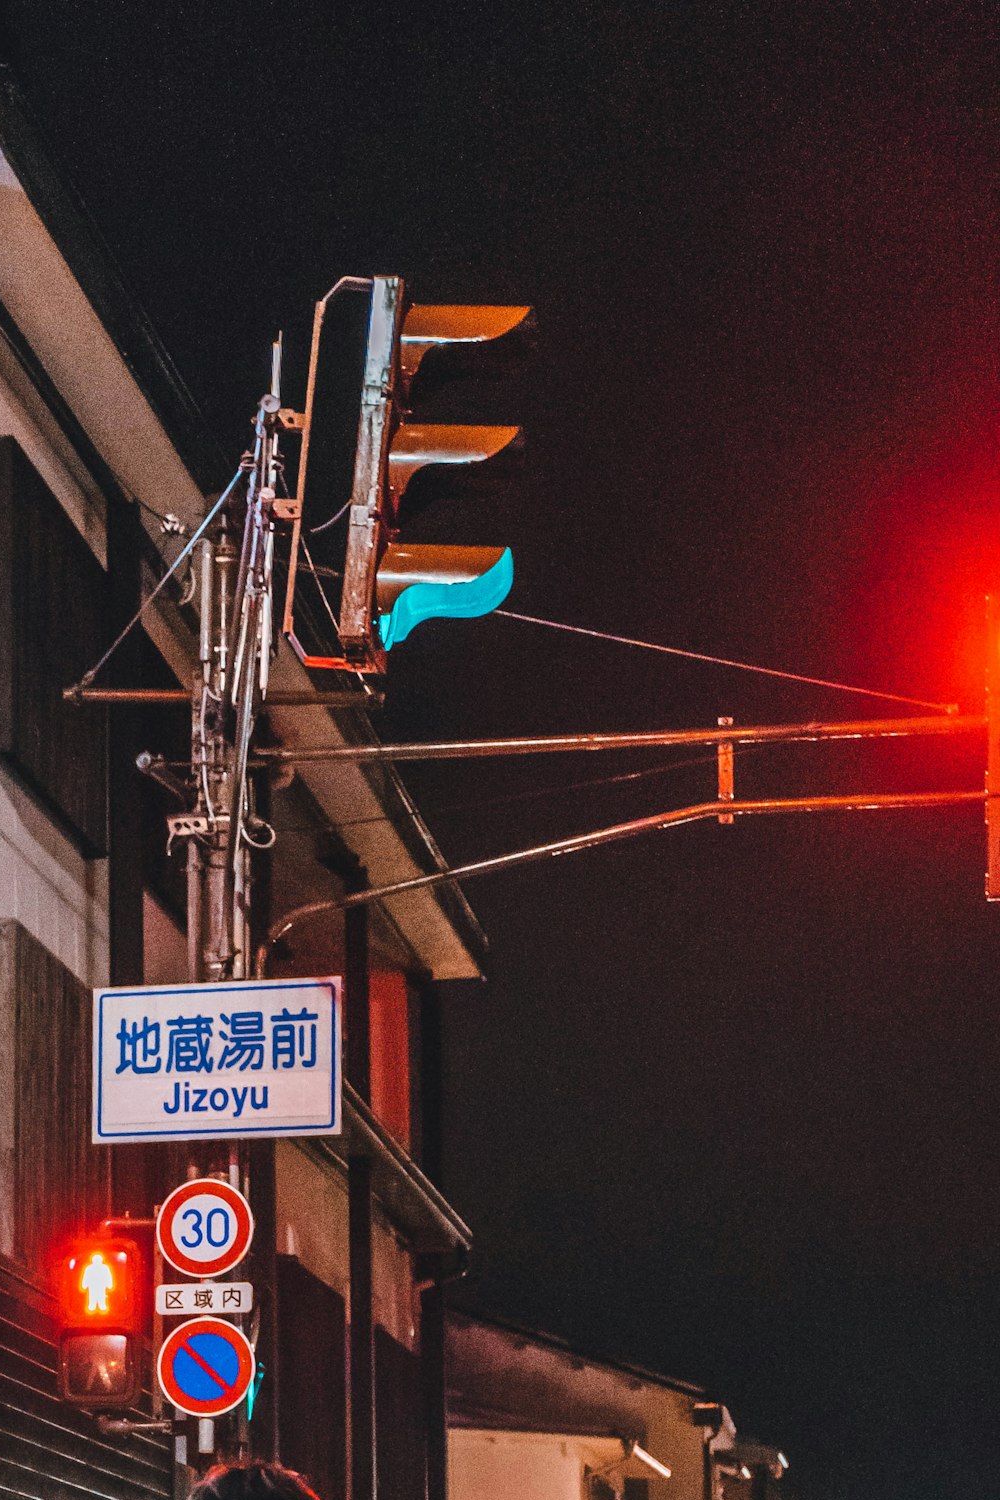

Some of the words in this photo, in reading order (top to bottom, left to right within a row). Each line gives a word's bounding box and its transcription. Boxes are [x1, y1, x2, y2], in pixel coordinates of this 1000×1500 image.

[115, 1007, 319, 1075] 地蔵湯前
[163, 1081, 269, 1118] Jizoyu
[180, 1207, 230, 1249] 30
[164, 1288, 243, 1309] 区域内
